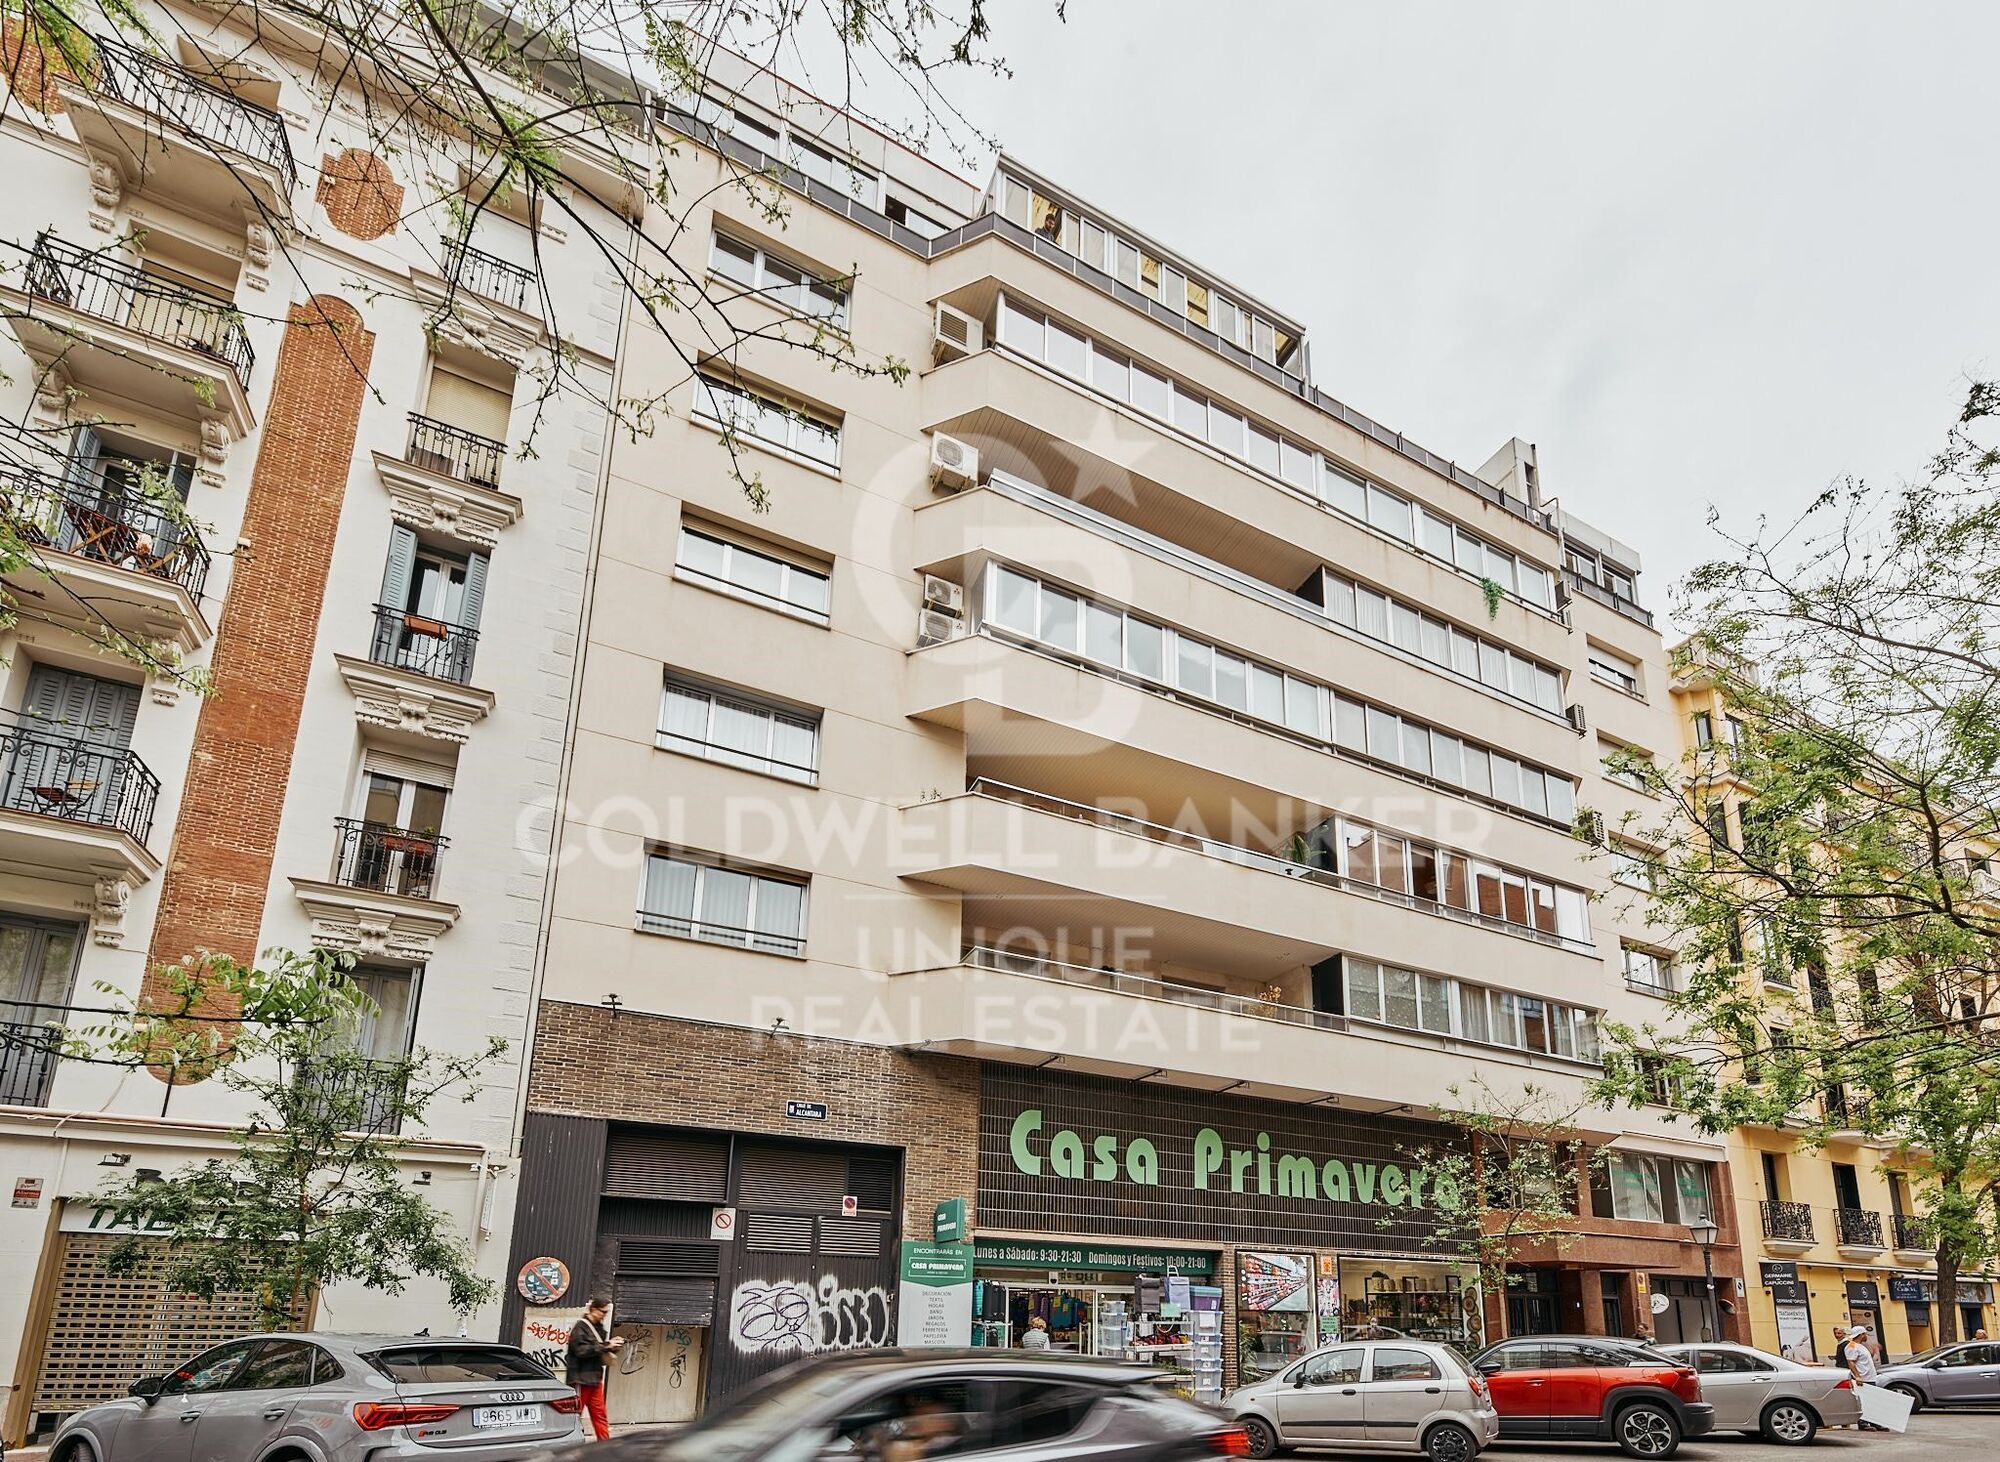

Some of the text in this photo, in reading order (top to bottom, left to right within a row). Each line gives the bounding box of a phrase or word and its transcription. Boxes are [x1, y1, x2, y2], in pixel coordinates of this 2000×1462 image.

[1010, 1110, 1460, 1211] Casa Primavera
[999, 1249, 1005, 1259] a
[1006, 1246, 1039, 1261] Sábado:
[1040, 1249, 1082, 1263] 9:30-21:30
[1088, 1252, 1126, 1266] Domingos
[1127, 1255, 1132, 1267] y
[1133, 1253, 1165, 1267] Festivos:
[1166, 1255, 1206, 1269] 10:00-21:00
